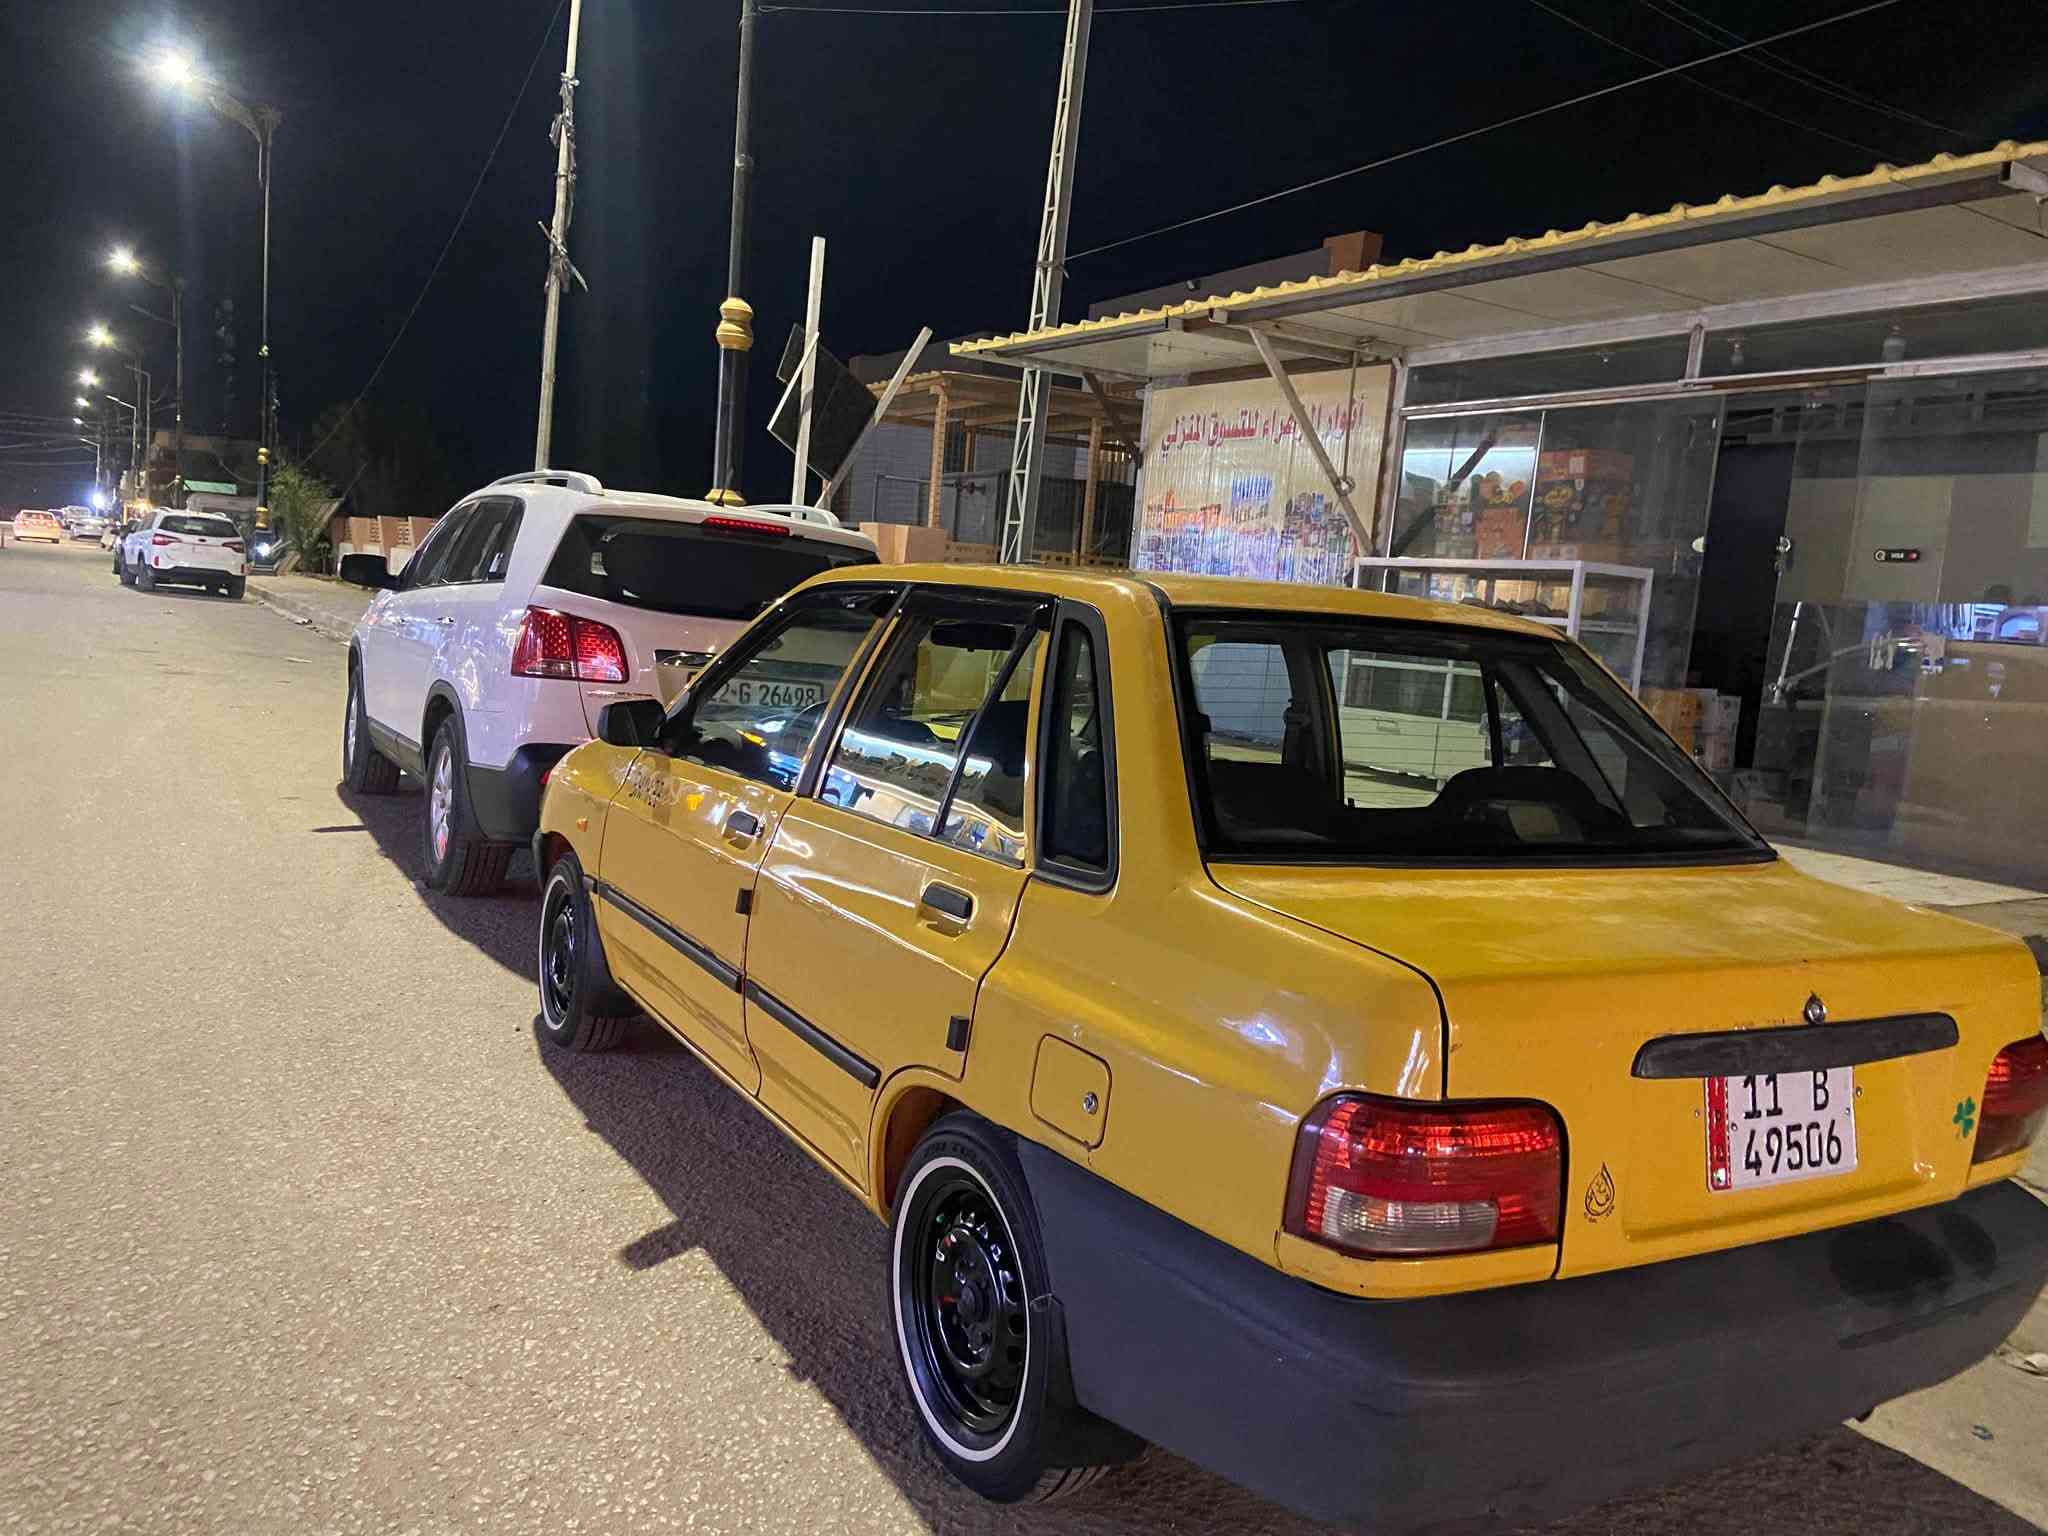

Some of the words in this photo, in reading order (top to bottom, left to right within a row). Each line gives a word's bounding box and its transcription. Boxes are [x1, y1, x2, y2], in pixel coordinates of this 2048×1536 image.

[1161, 414, 1206, 458] المنزلي
[758, 683, 817, 708] 26498
[1743, 1074, 1783, 1119] 11
[1813, 1070, 1830, 1112] B
[1744, 1119, 1843, 1177] 49506
